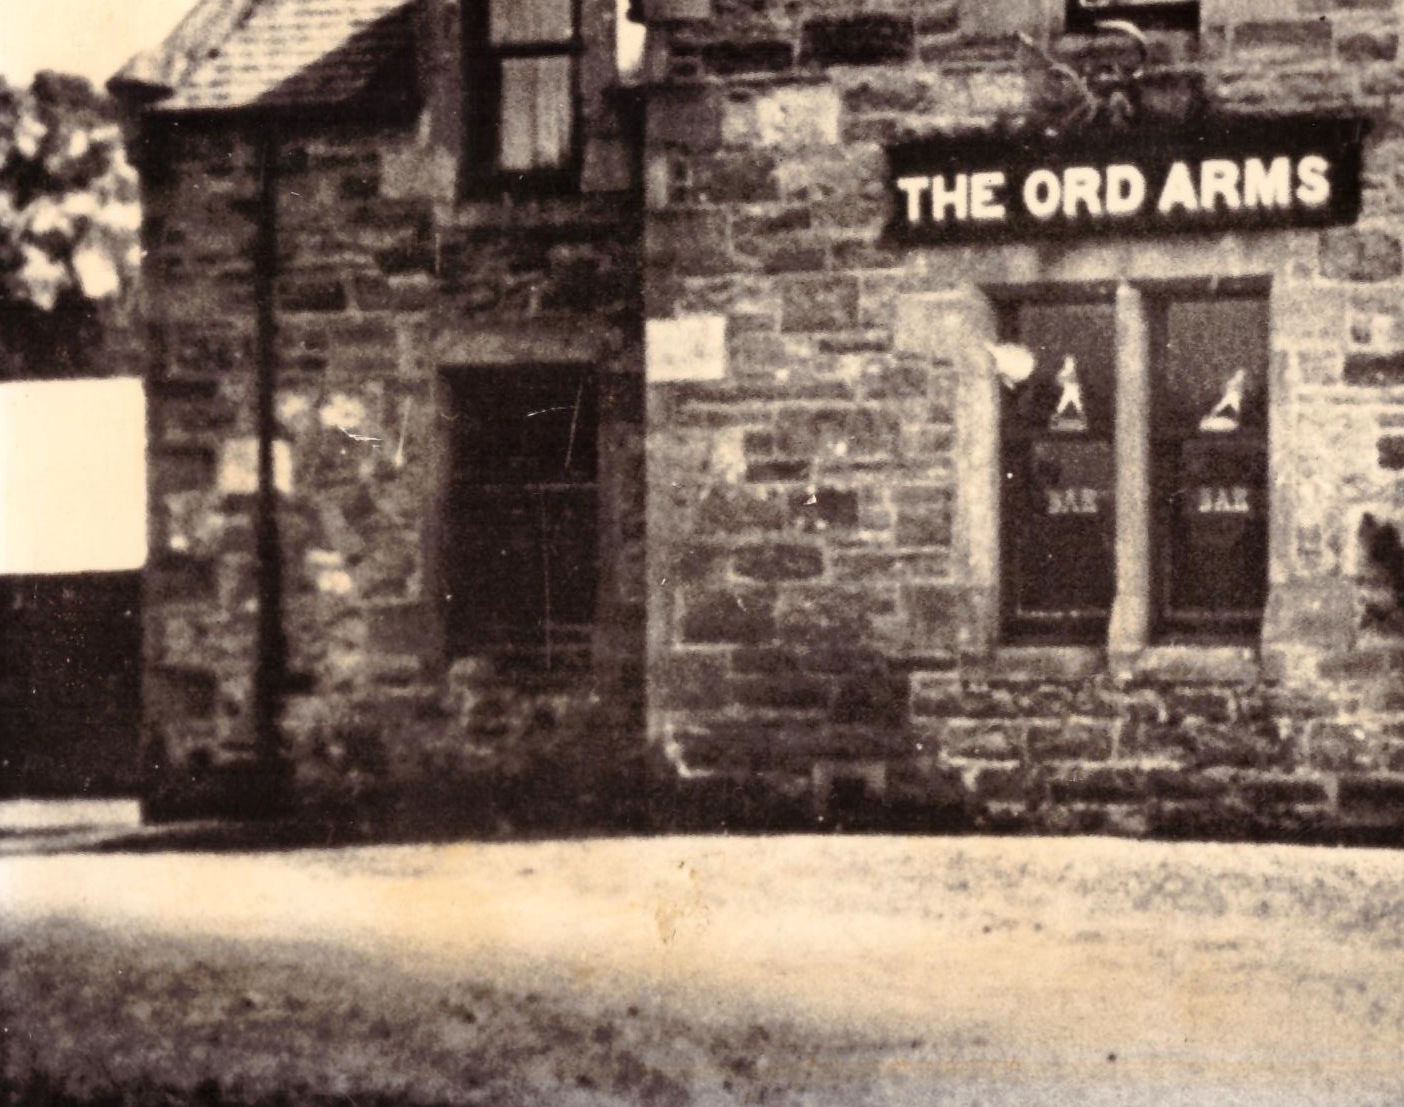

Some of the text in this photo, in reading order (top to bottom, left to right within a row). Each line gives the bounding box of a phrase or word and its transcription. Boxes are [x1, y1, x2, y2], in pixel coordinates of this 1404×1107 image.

[897, 155, 1330, 223] THE ORD ARMS
